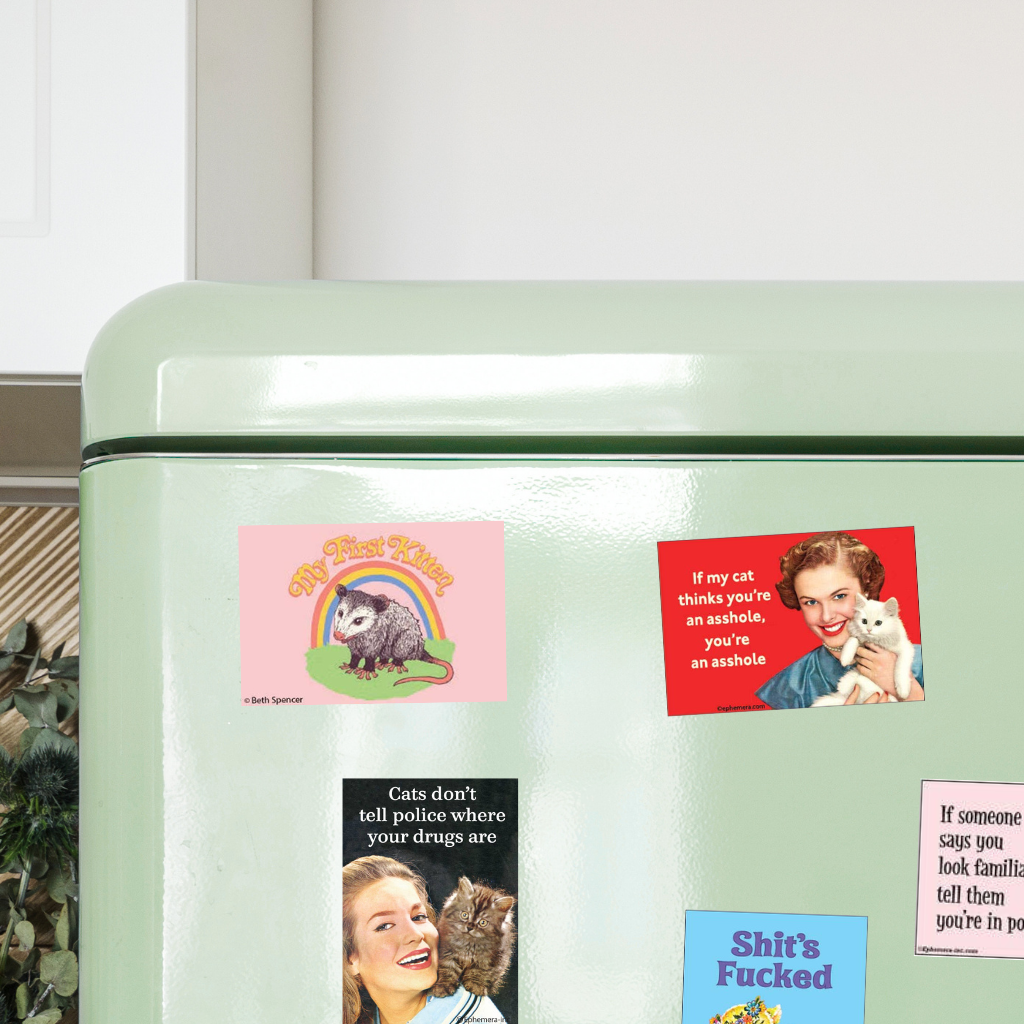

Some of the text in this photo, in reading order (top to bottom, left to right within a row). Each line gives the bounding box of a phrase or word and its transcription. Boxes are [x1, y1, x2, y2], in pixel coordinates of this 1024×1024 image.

[288, 534, 455, 598] My First Kitten
[692, 570, 755, 587] If my cat
[678, 589, 771, 607] thinks you’re
[686, 610, 766, 626] an asshole,
[705, 633, 750, 651] you’re
[691, 653, 767, 669] an asshole
[251, 696, 270, 704] Beth
[271, 696, 304, 706] Spencer
[388, 785, 477, 801] Cats don’t
[359, 807, 506, 826] tell police where
[941, 805, 1022, 826] If someone
[367, 829, 497, 848] your drugs are
[939, 833, 1004, 852] says you
[938, 856, 970, 877] look
[937, 885, 1005, 906] tell them
[936, 910, 982, 933] you're
[987, 912, 1002, 931] in
[731, 930, 821, 960] Shit’s
[716, 960, 833, 990] Fucked
